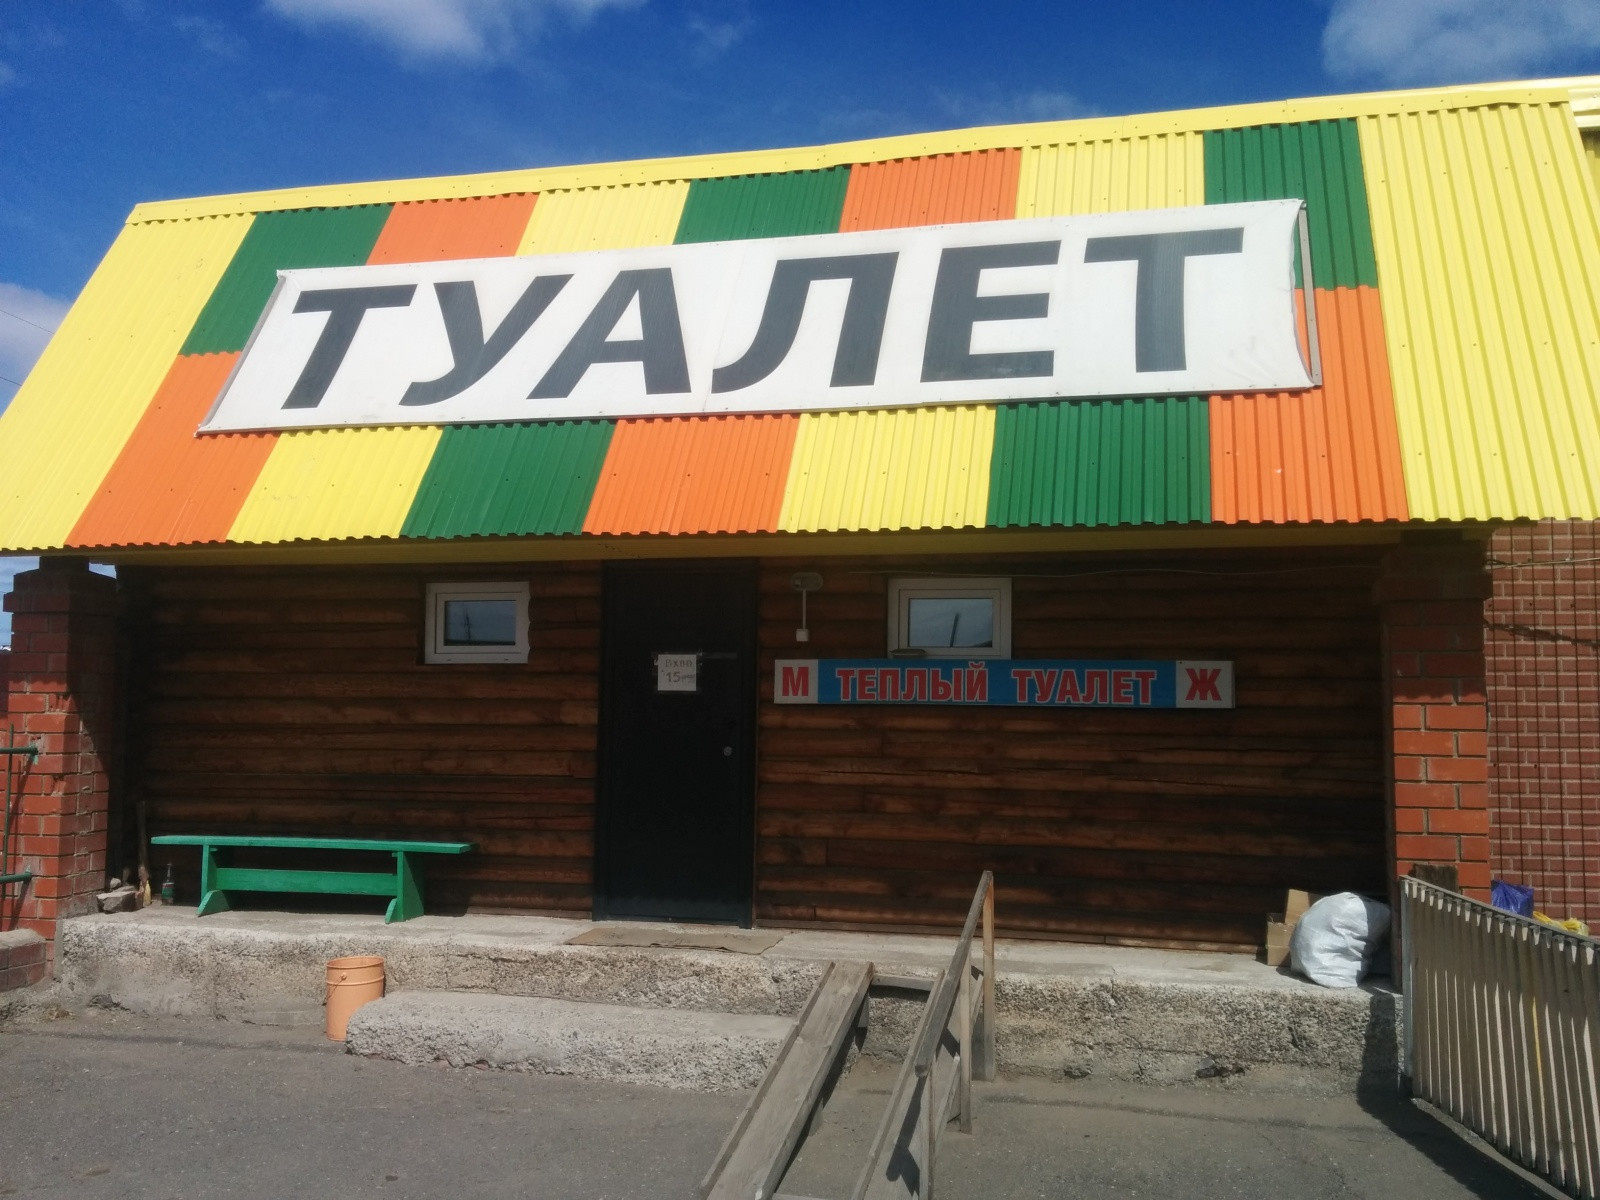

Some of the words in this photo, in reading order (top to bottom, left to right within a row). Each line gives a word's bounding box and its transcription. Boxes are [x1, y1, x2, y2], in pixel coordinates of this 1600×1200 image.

[282, 227, 1244, 409] ТУАЛЕТ
[782, 666, 809, 697] М
[835, 662, 989, 703] ТЕПЛЫЙ
[1011, 669, 1157, 705] ТУАЛЕТ
[1185, 668, 1222, 701] Ж
